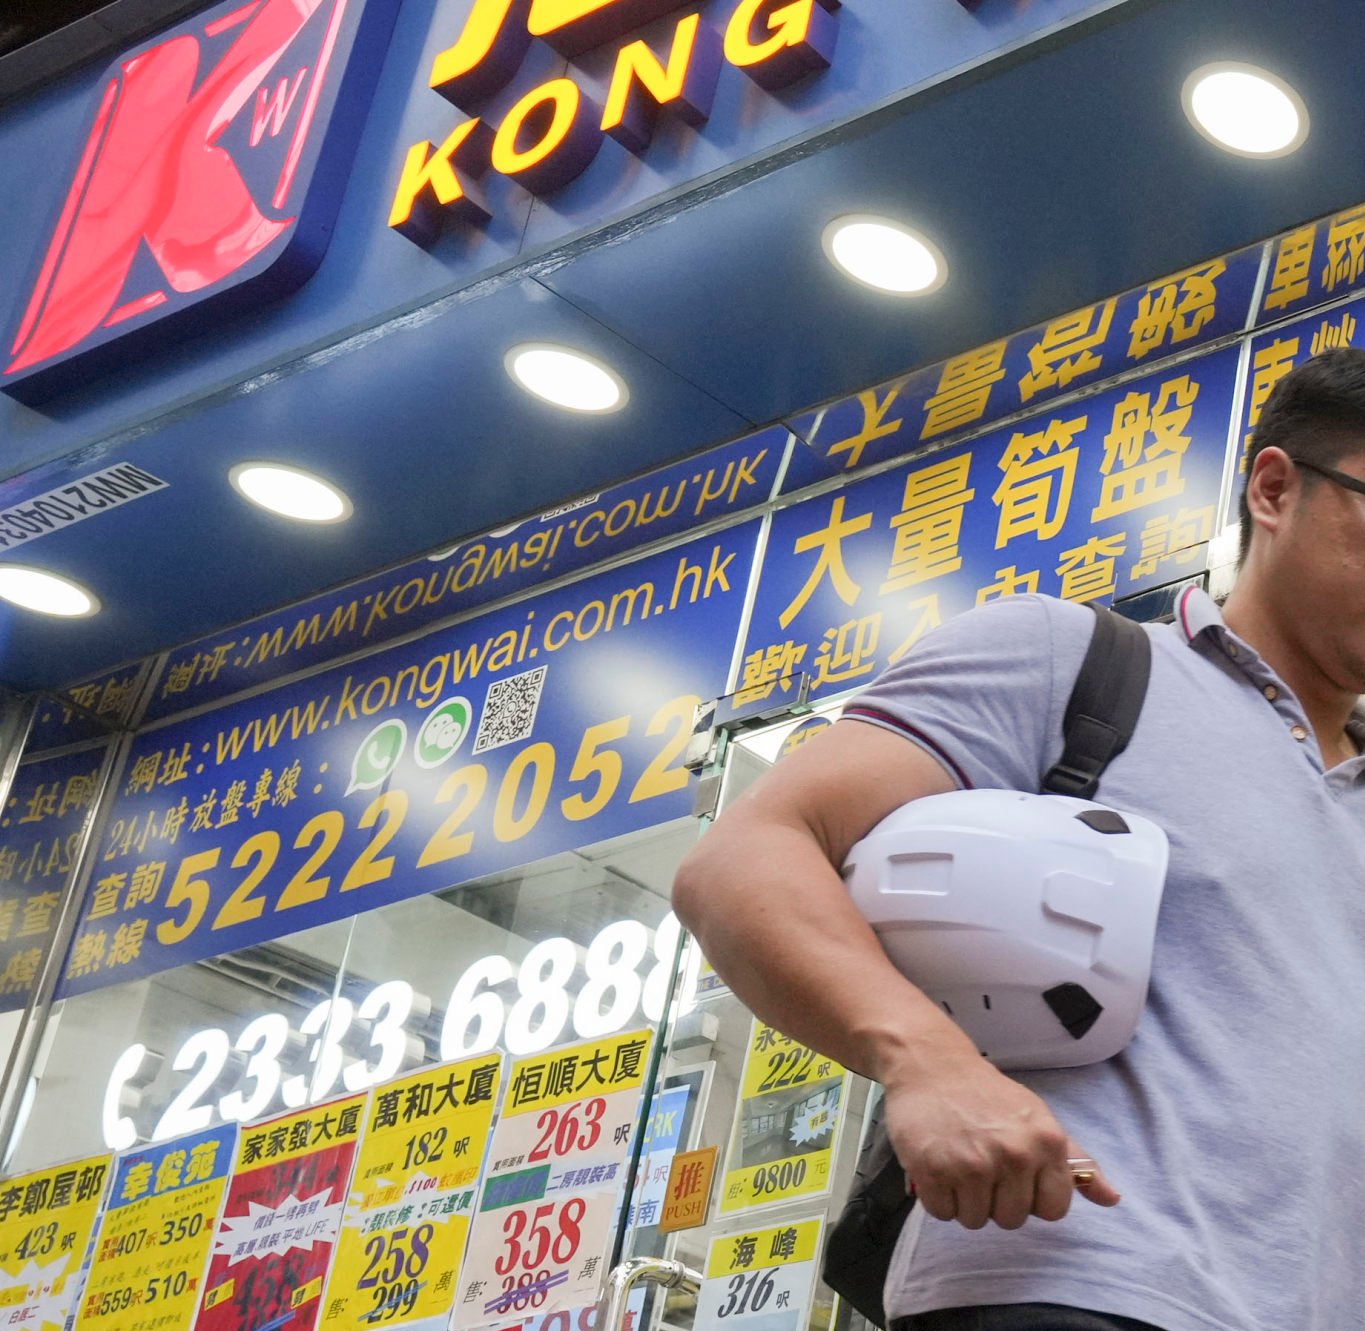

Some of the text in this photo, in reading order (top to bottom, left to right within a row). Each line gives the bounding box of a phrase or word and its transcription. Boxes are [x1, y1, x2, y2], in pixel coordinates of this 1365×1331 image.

[388, 0, 812, 229] KONG
[779, 375, 1201, 629] 大量筍盤
[90, 863, 163, 916] 查詢
[67, 919, 149, 980] 熱線
[372, 1062, 499, 1133] 萬和大廈
[527, 1097, 606, 1163] 263
[402, 1127, 448, 1170] 182
[674, 1159, 704, 1200] 推
[495, 1196, 587, 1277] 358
[666, 1200, 702, 1221] PUSH
[357, 1223, 434, 1291] 258
